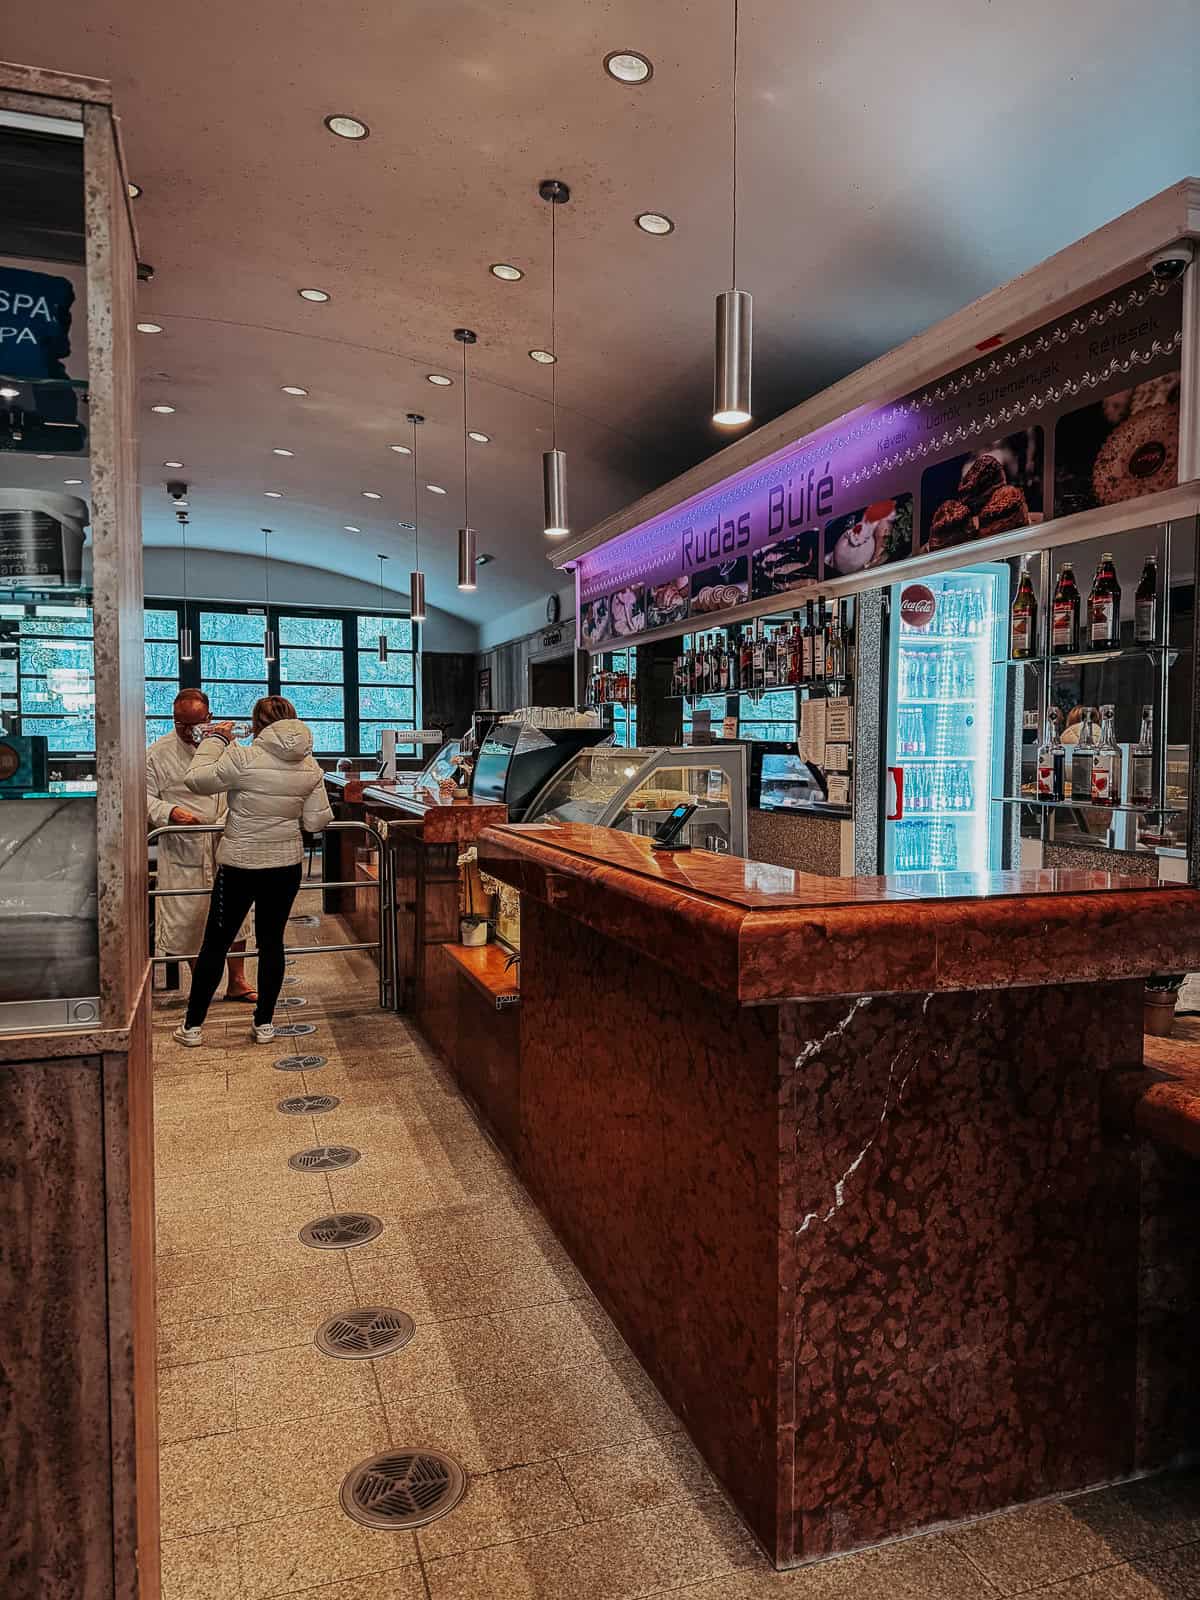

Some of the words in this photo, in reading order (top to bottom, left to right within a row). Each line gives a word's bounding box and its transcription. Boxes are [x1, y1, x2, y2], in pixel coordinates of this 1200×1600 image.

[0, 289, 52, 322] SPA
[681, 512, 751, 571] Rudas
[768, 461, 834, 537] Büfé
